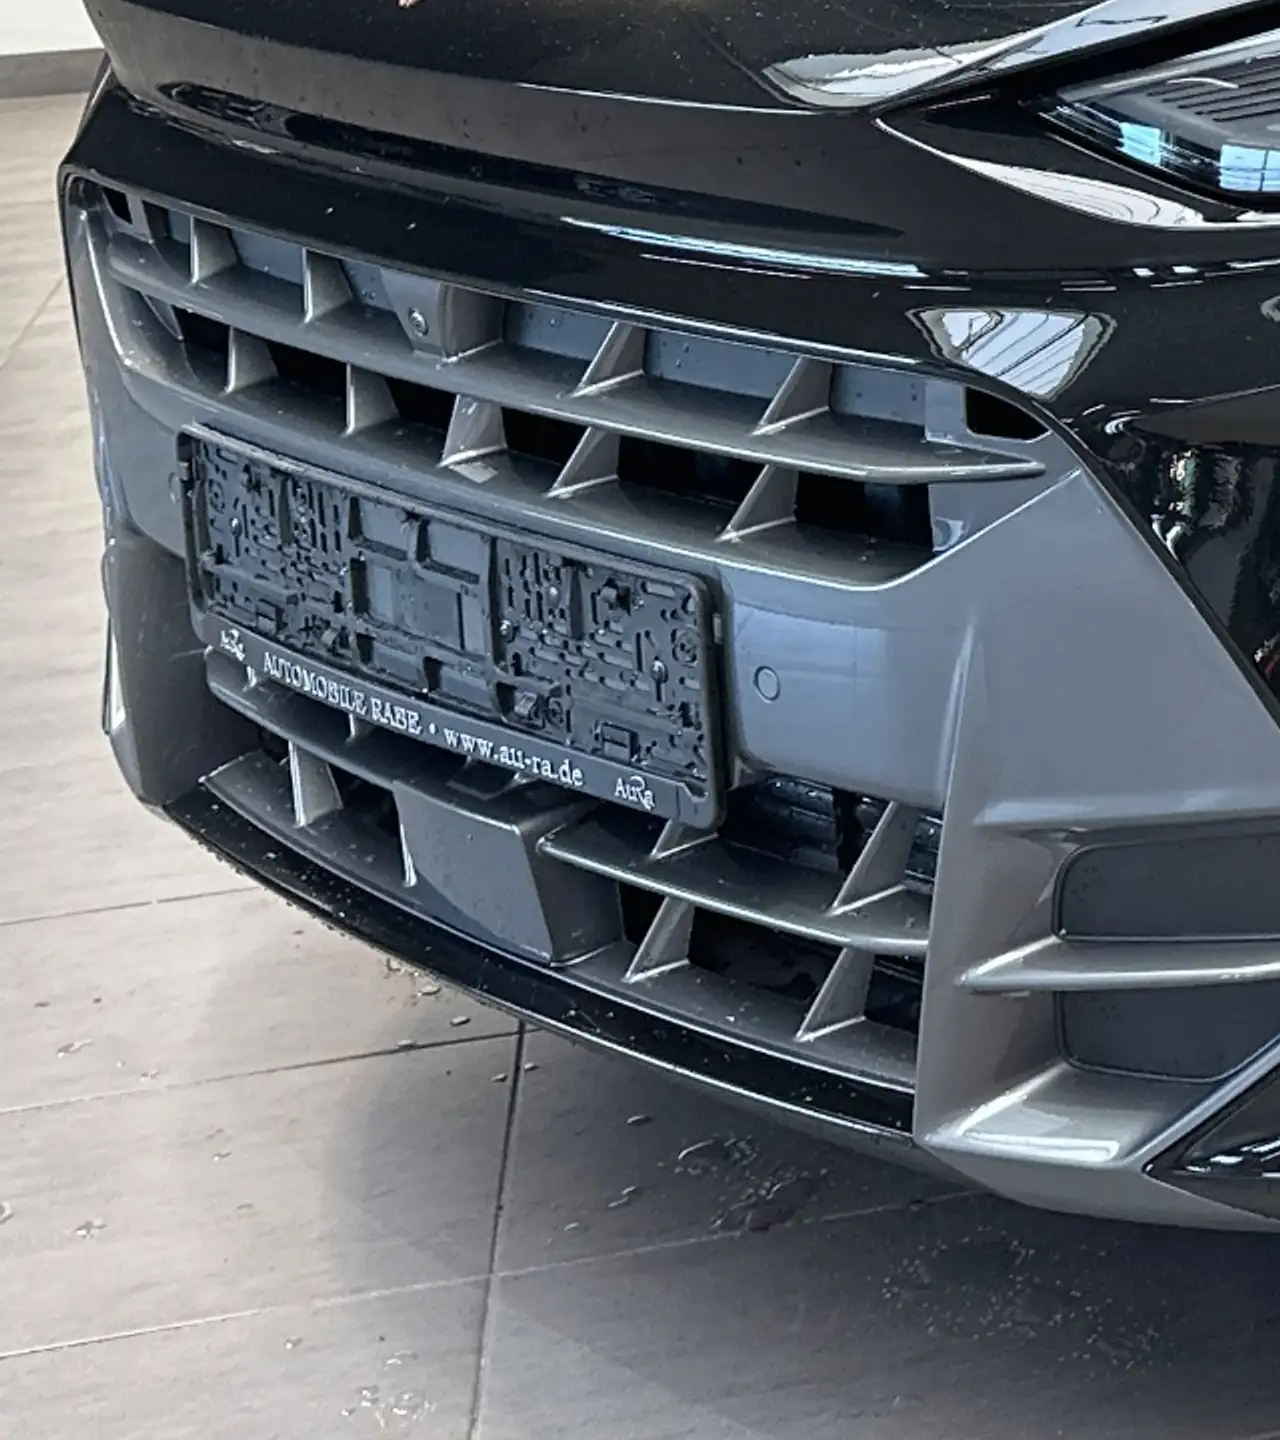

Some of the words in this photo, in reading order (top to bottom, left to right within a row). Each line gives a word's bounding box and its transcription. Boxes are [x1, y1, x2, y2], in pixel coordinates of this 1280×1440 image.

[263, 651, 368, 716] AUTOMOBILE
[370, 696, 423, 735] RABE
[443, 727, 585, 787] www.au-ra.de
